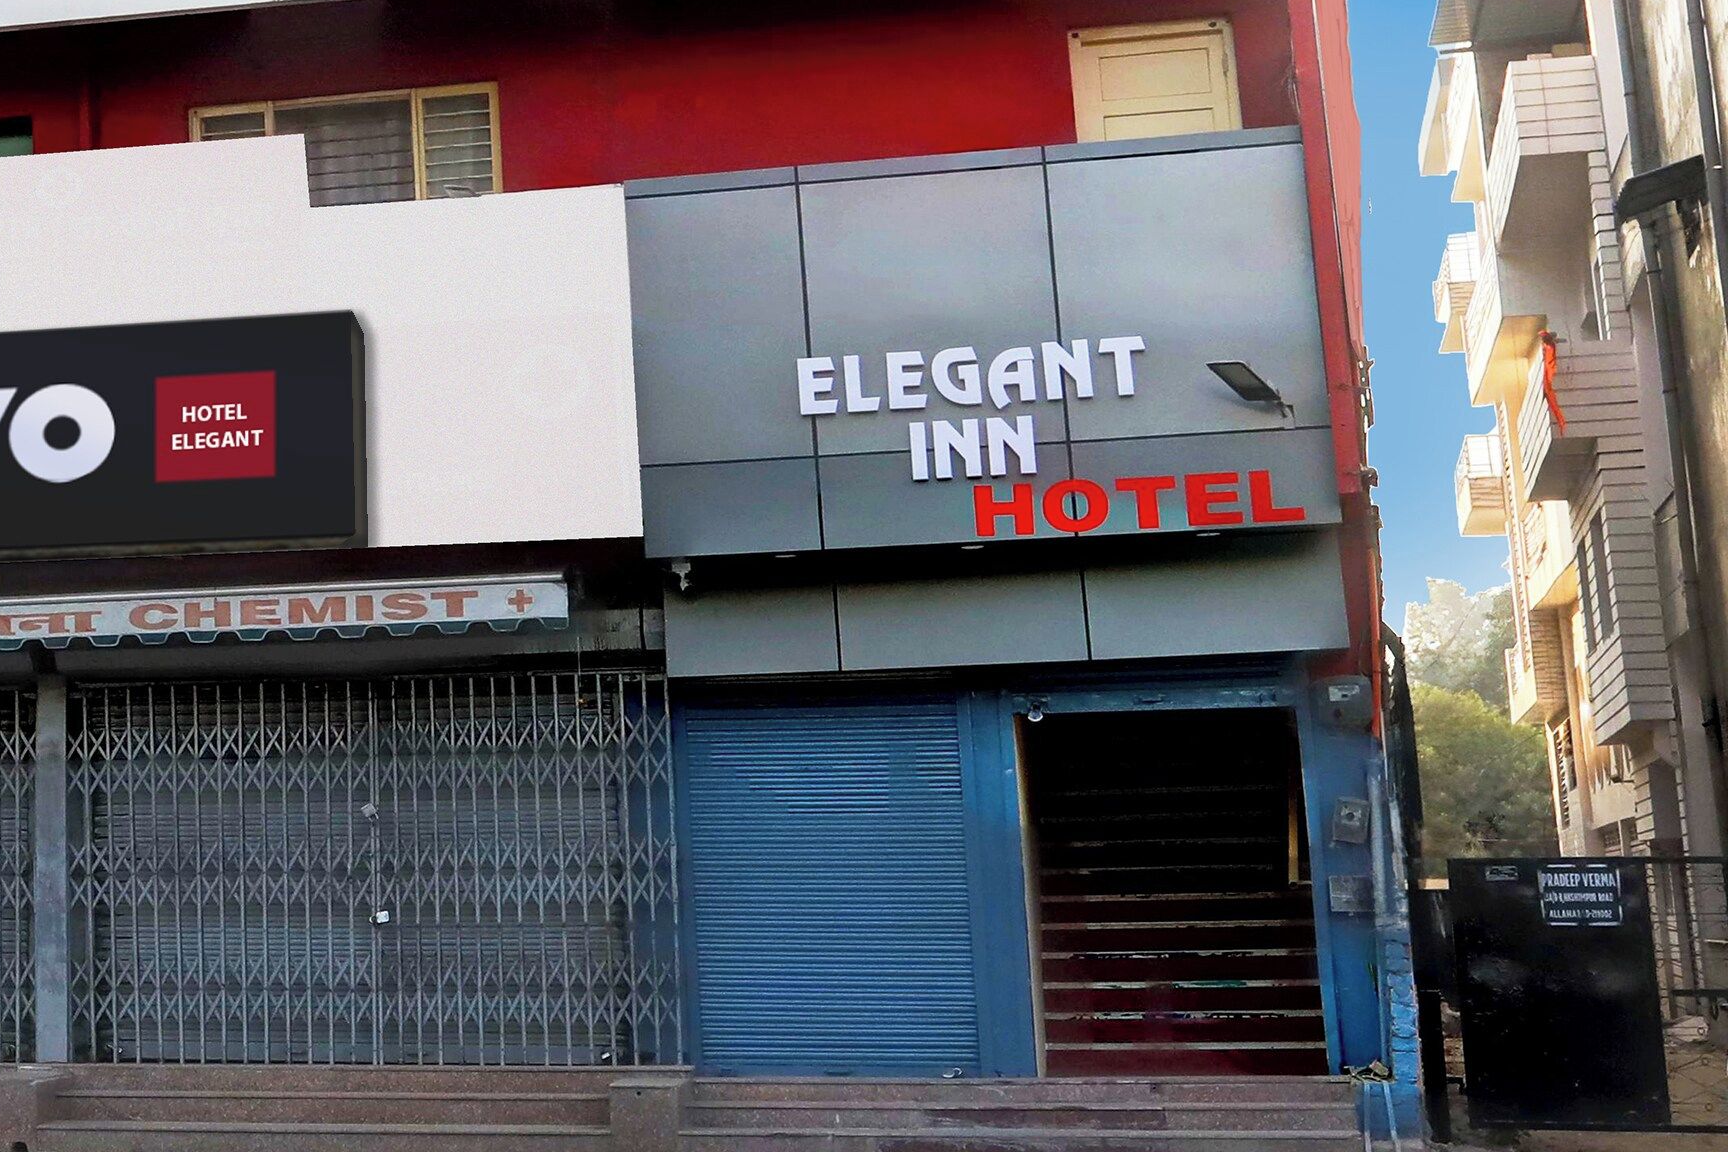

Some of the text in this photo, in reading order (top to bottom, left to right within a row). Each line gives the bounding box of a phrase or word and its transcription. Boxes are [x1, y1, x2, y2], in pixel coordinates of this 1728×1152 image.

[796, 335, 1146, 415] ELEGANT
[182, 403, 248, 423] HOTEL
[172, 429, 264, 450] ELEGANT
[909, 414, 1038, 481] INN
[973, 469, 1307, 537] HOTEL
[128, 589, 479, 631] CHEMIST
[1542, 872, 1616, 887] PRADEEP VERMA
